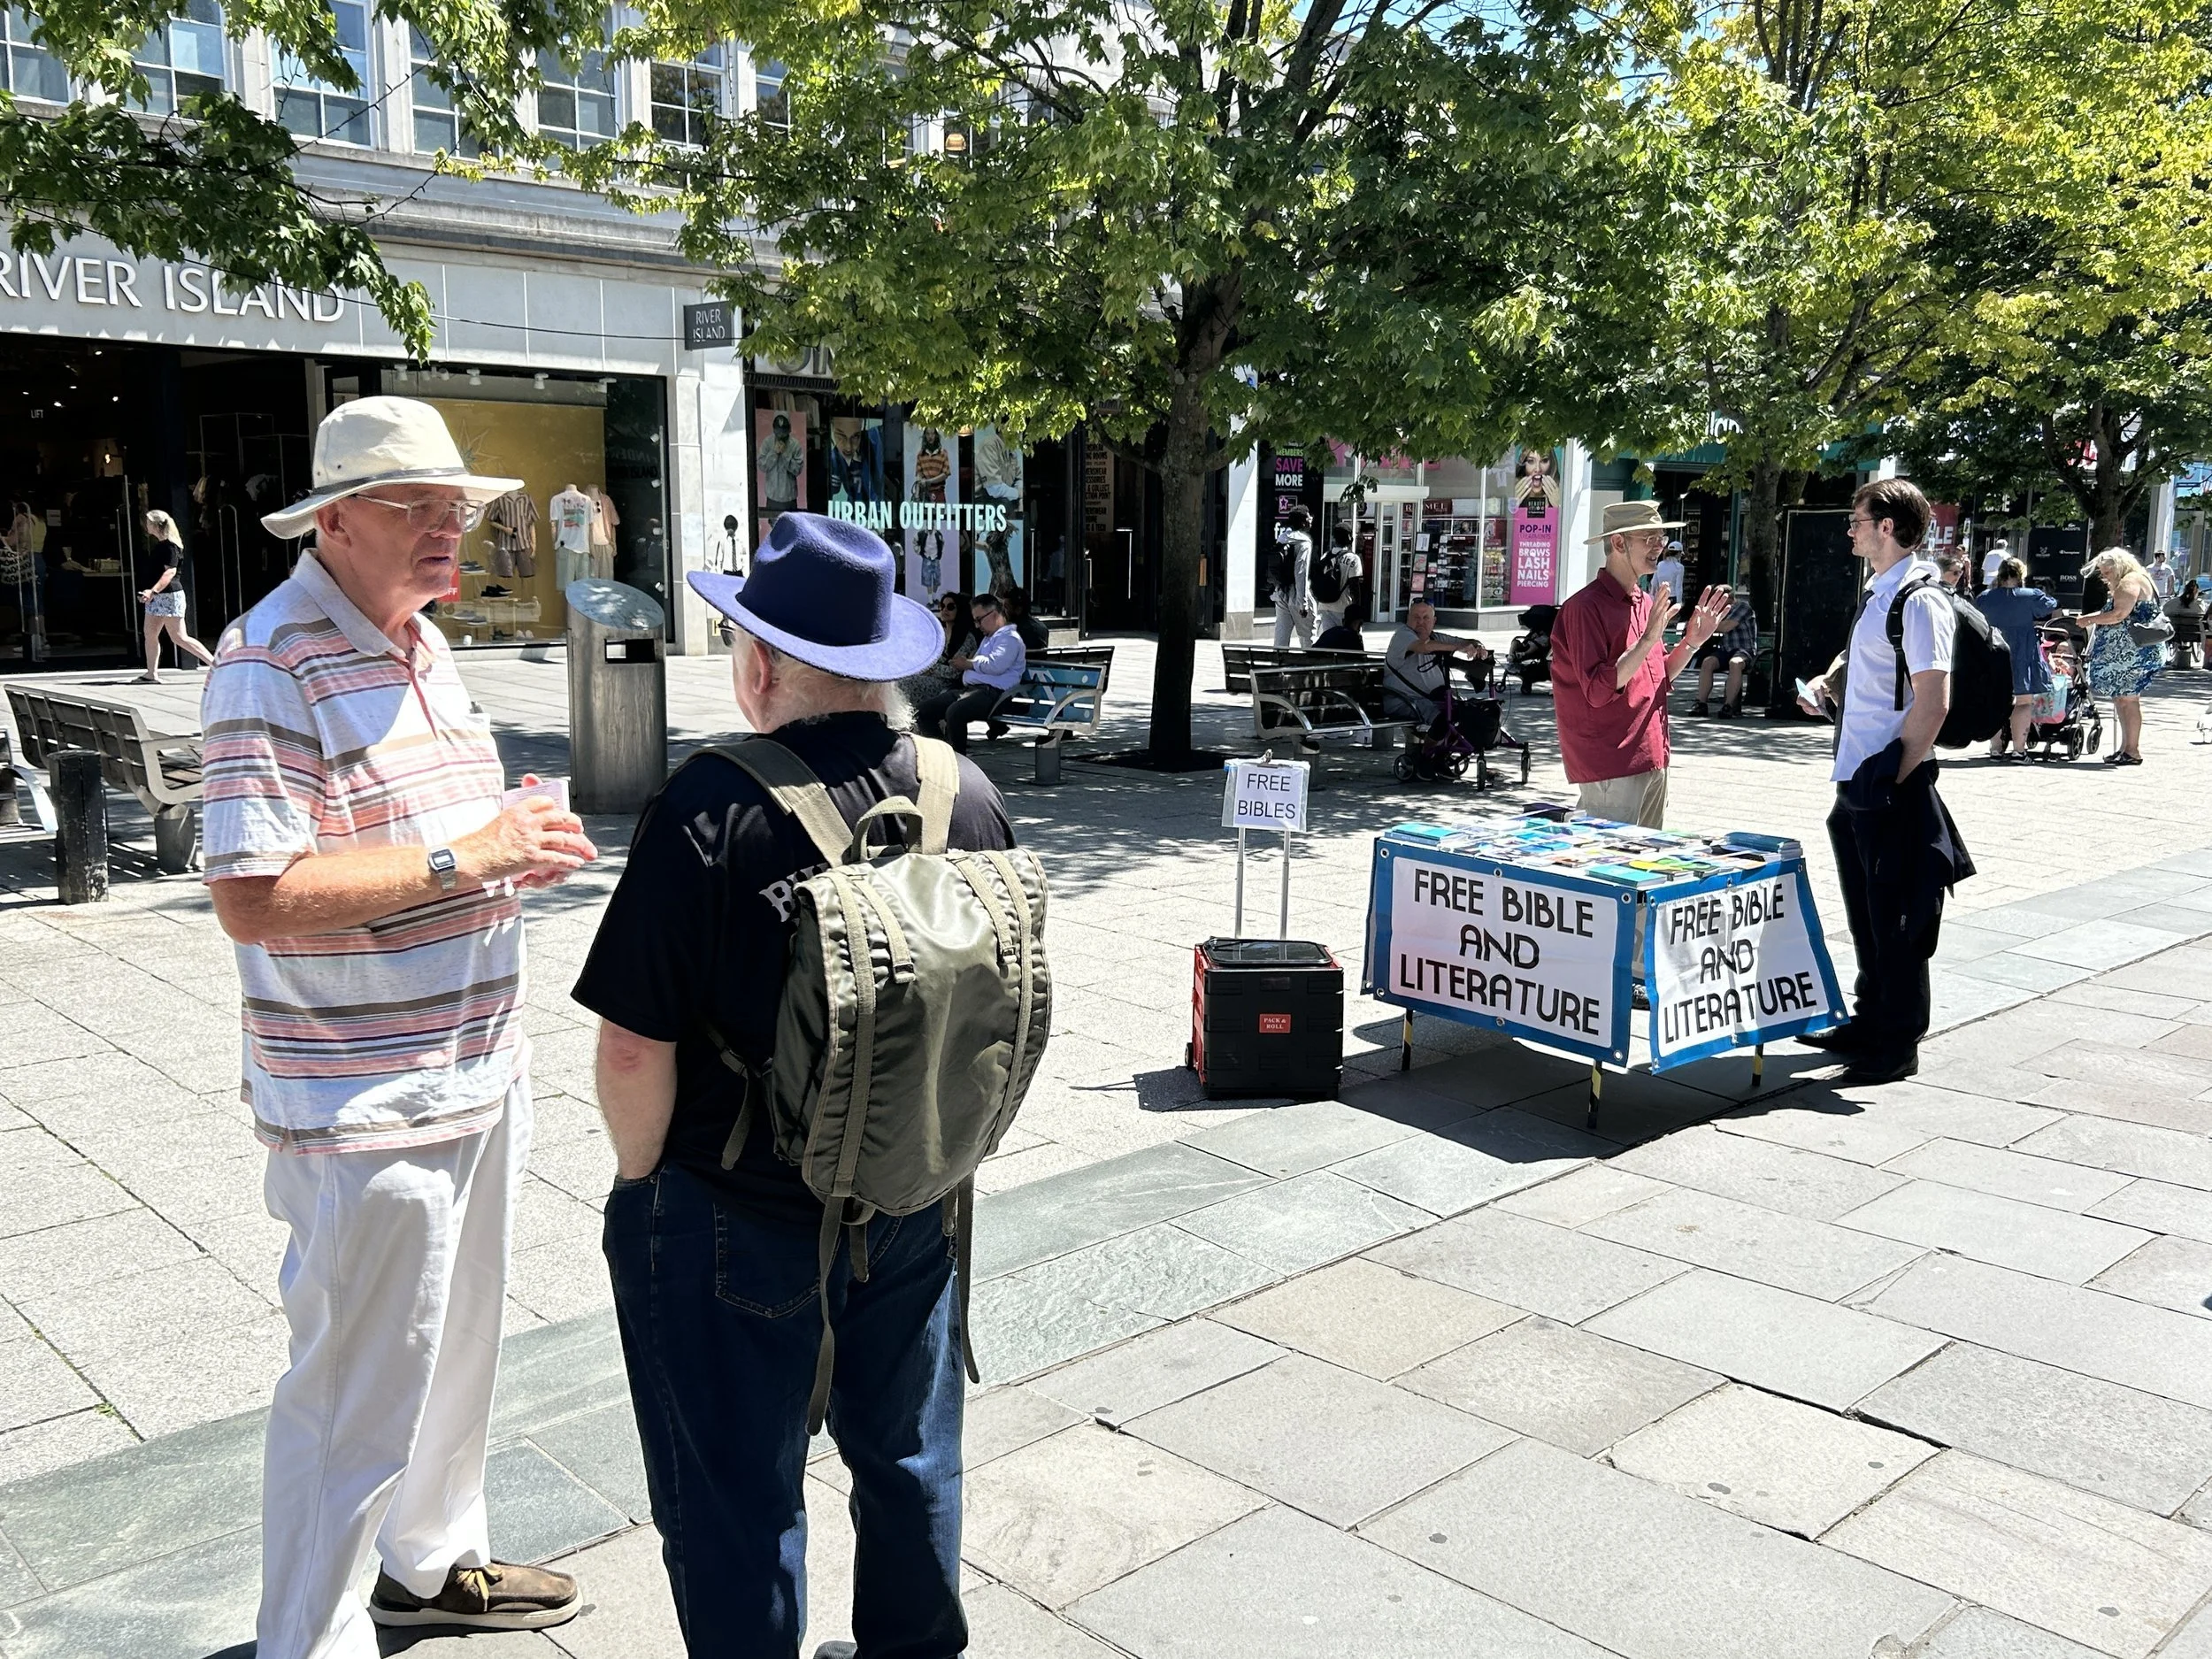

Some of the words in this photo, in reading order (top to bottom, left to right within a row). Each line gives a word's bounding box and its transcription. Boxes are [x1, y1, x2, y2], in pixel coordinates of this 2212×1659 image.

[163, 265, 345, 322] ISLAND
[695, 308, 721, 326] RIVER
[693, 326, 726, 342] ISLAND
[30, 409, 44, 419] LIFT
[1276, 457, 1303, 472] SAVE
[1275, 473, 1303, 487] MORE
[828, 501, 892, 529] URBAN
[899, 501, 1007, 532] OUTFITTERS
[1519, 524, 1552, 533] POP-IN
[1518, 548, 1551, 557] BROWS
[1517, 557, 1550, 570] LASH
[1517, 569, 1550, 580] NAILS
[1247, 773, 1291, 792] FREE
[1238, 800, 1295, 819] BIBLES
[1415, 868, 1484, 917] FREE
[1502, 886, 1594, 938] BIBLE
[1669, 899, 1721, 946] FREE
[1731, 883, 1785, 930] BIBLE
[1459, 924, 1540, 970] AND
[1700, 939, 1755, 984] AND
[1400, 953, 1600, 1036] LITERATURE
[1663, 971, 1817, 1044] LITERATURE
